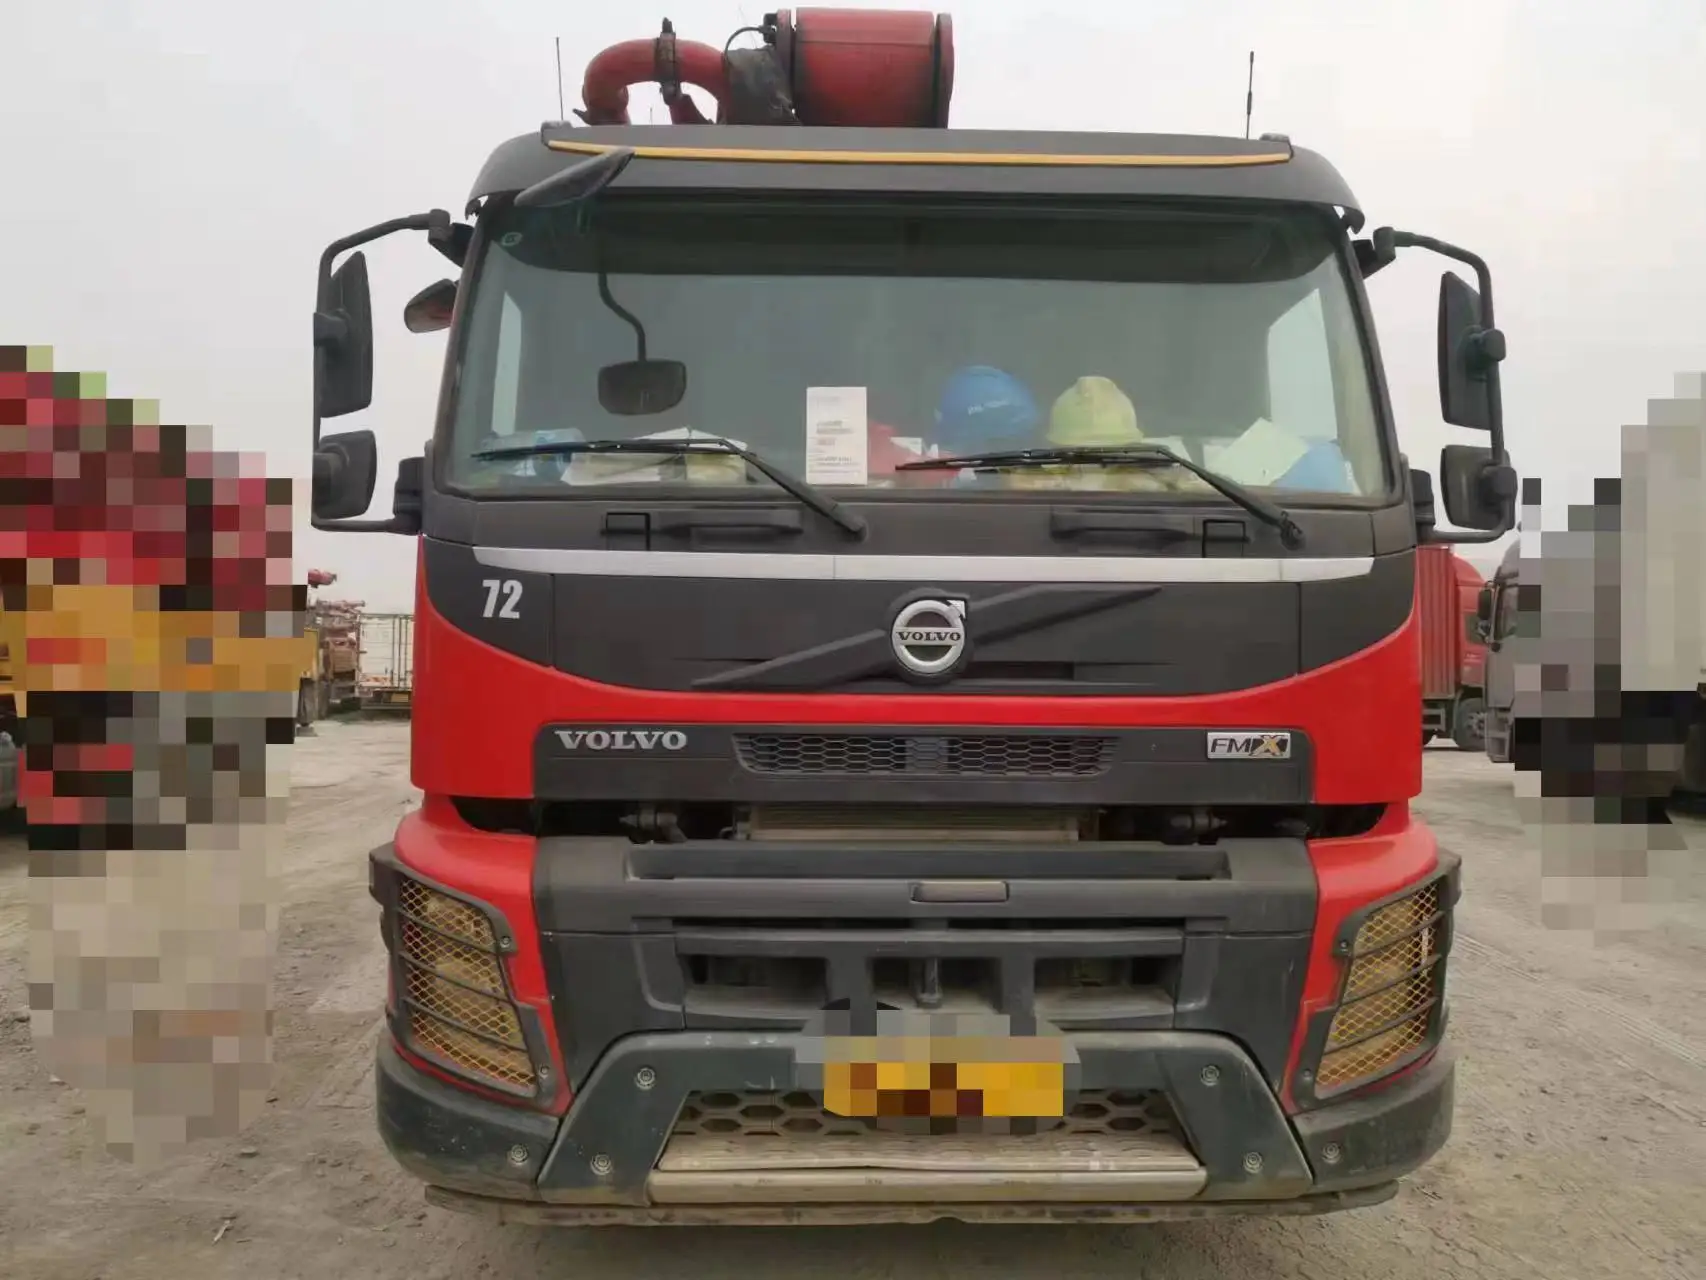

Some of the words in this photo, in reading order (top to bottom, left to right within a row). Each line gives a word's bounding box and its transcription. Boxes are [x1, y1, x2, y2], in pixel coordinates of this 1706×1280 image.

[482, 579, 522, 619] 72
[896, 631, 961, 641] VOLVO
[554, 730, 688, 750] VOLVO
[1210, 735, 1288, 756] FMX
